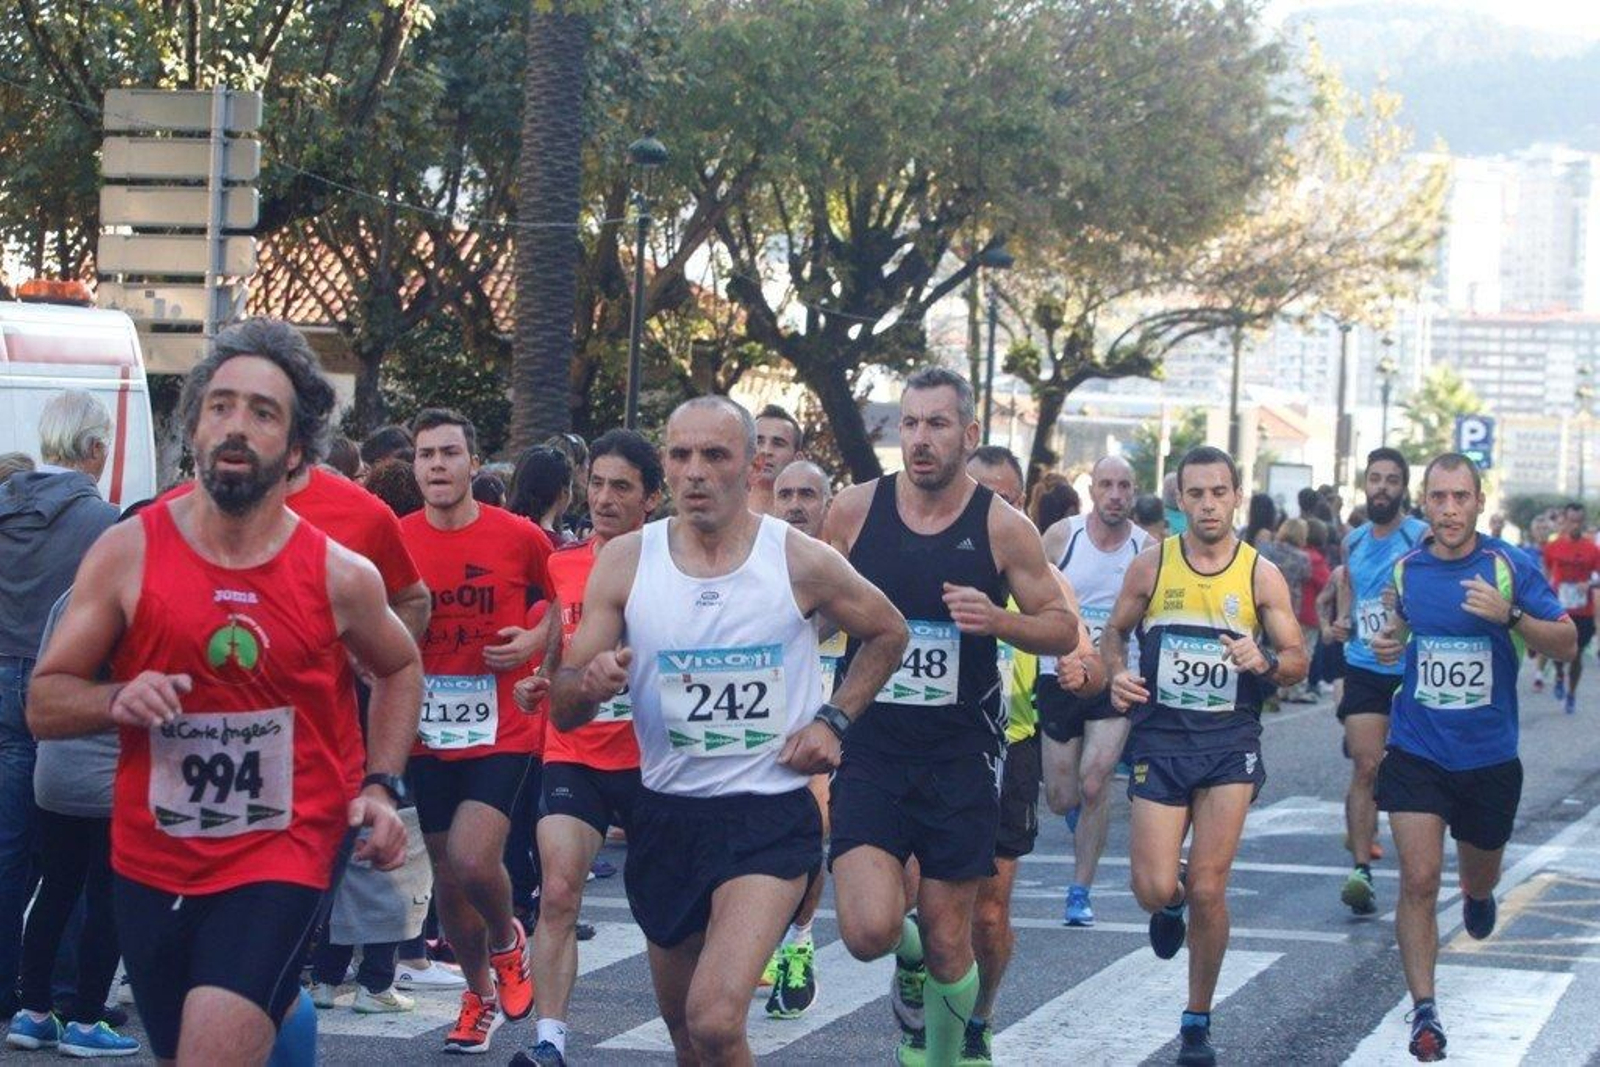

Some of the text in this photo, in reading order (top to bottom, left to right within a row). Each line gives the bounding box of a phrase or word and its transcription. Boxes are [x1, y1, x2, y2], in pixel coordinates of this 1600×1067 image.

[1461, 420, 1487, 450] P
[1172, 660, 1229, 689] 390
[1420, 660, 1485, 688] 1062
[421, 702, 490, 723] 1129
[686, 681, 770, 722] 242
[181, 751, 264, 803] 994
